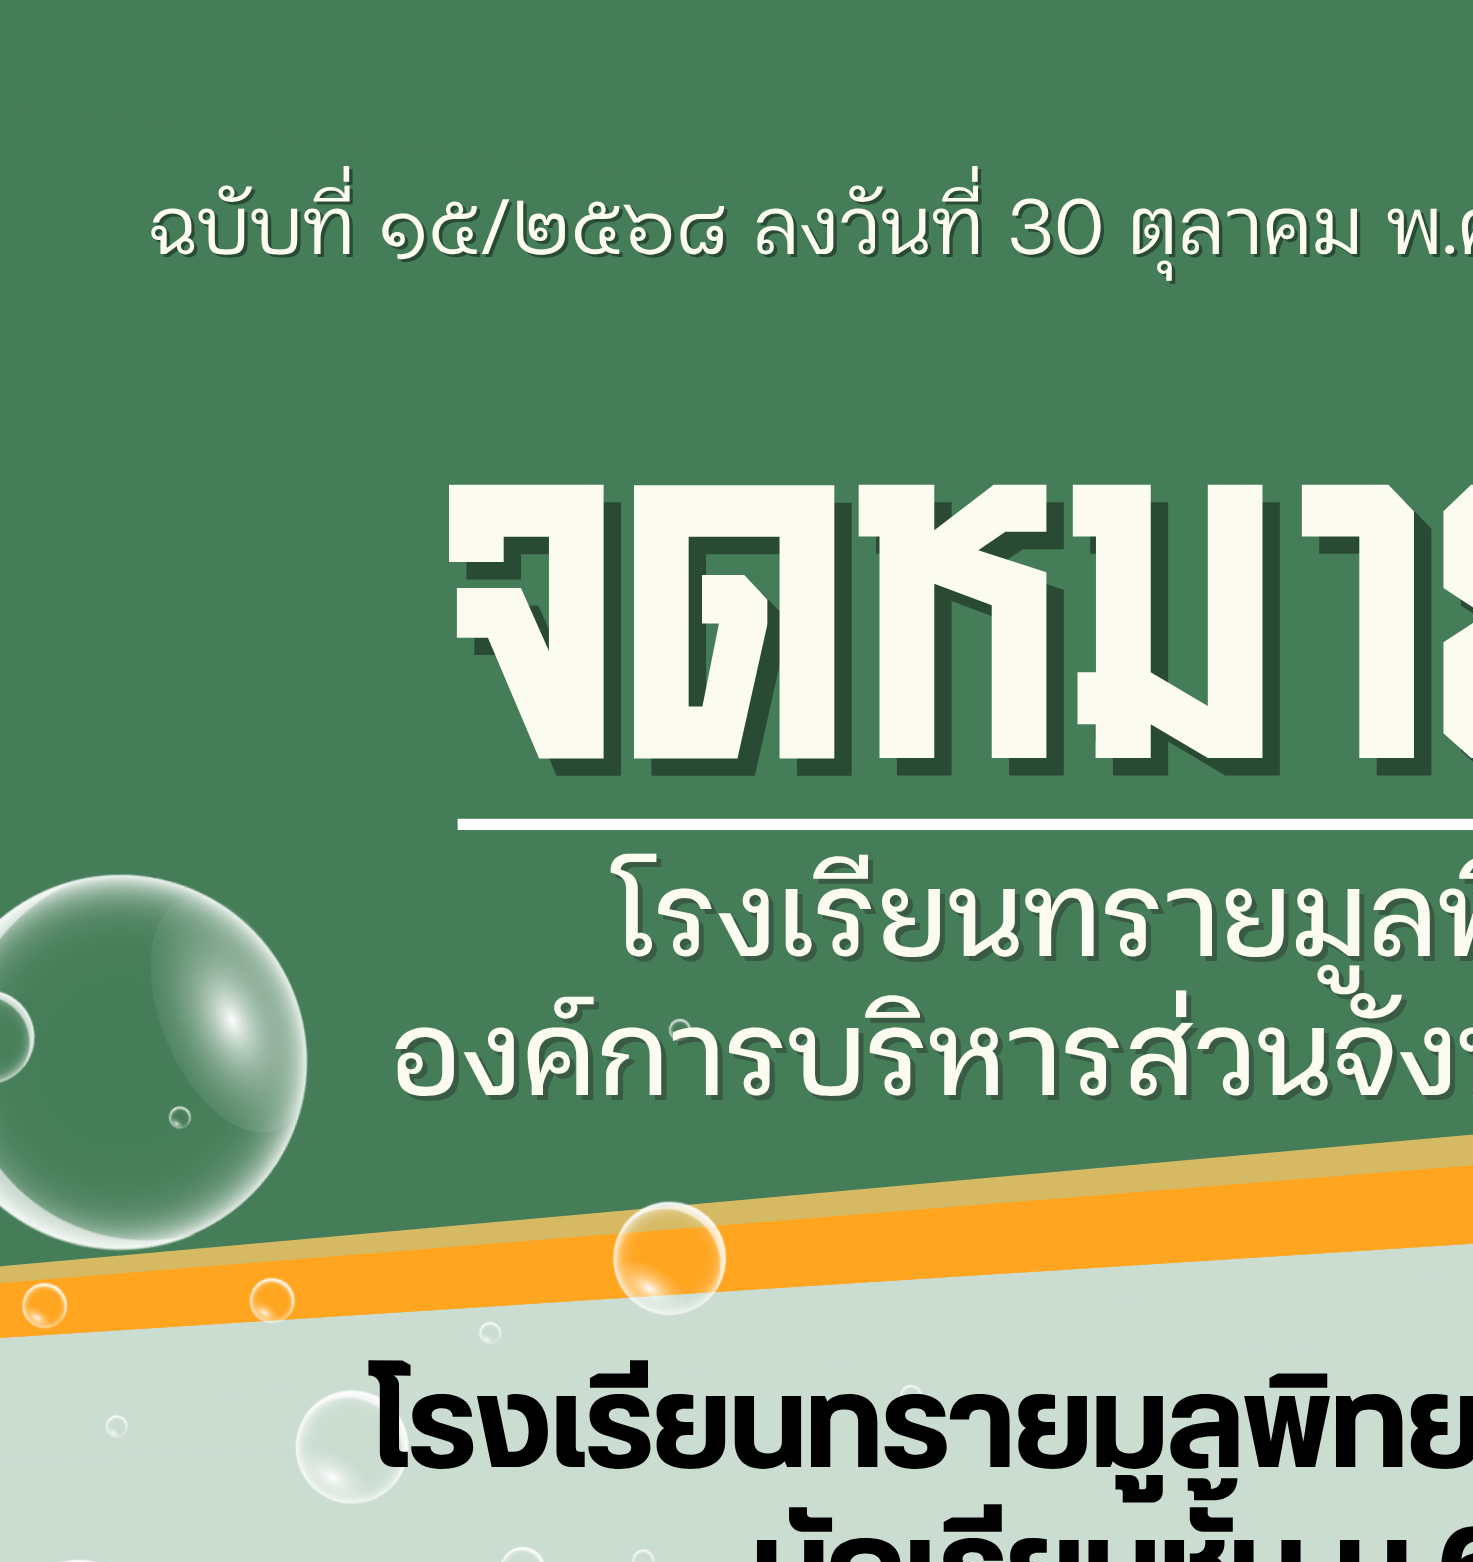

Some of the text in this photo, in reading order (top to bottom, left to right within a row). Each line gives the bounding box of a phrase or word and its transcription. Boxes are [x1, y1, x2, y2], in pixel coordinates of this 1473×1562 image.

[150, 164, 351, 256] ฉบับที่
[381, 191, 726, 261] ๑๕/๒๕๖๘
[755, 164, 980, 256] ลงวันที่
[1009, 197, 1102, 256] 30
[1131, 196, 1359, 283] ตุลาคม
